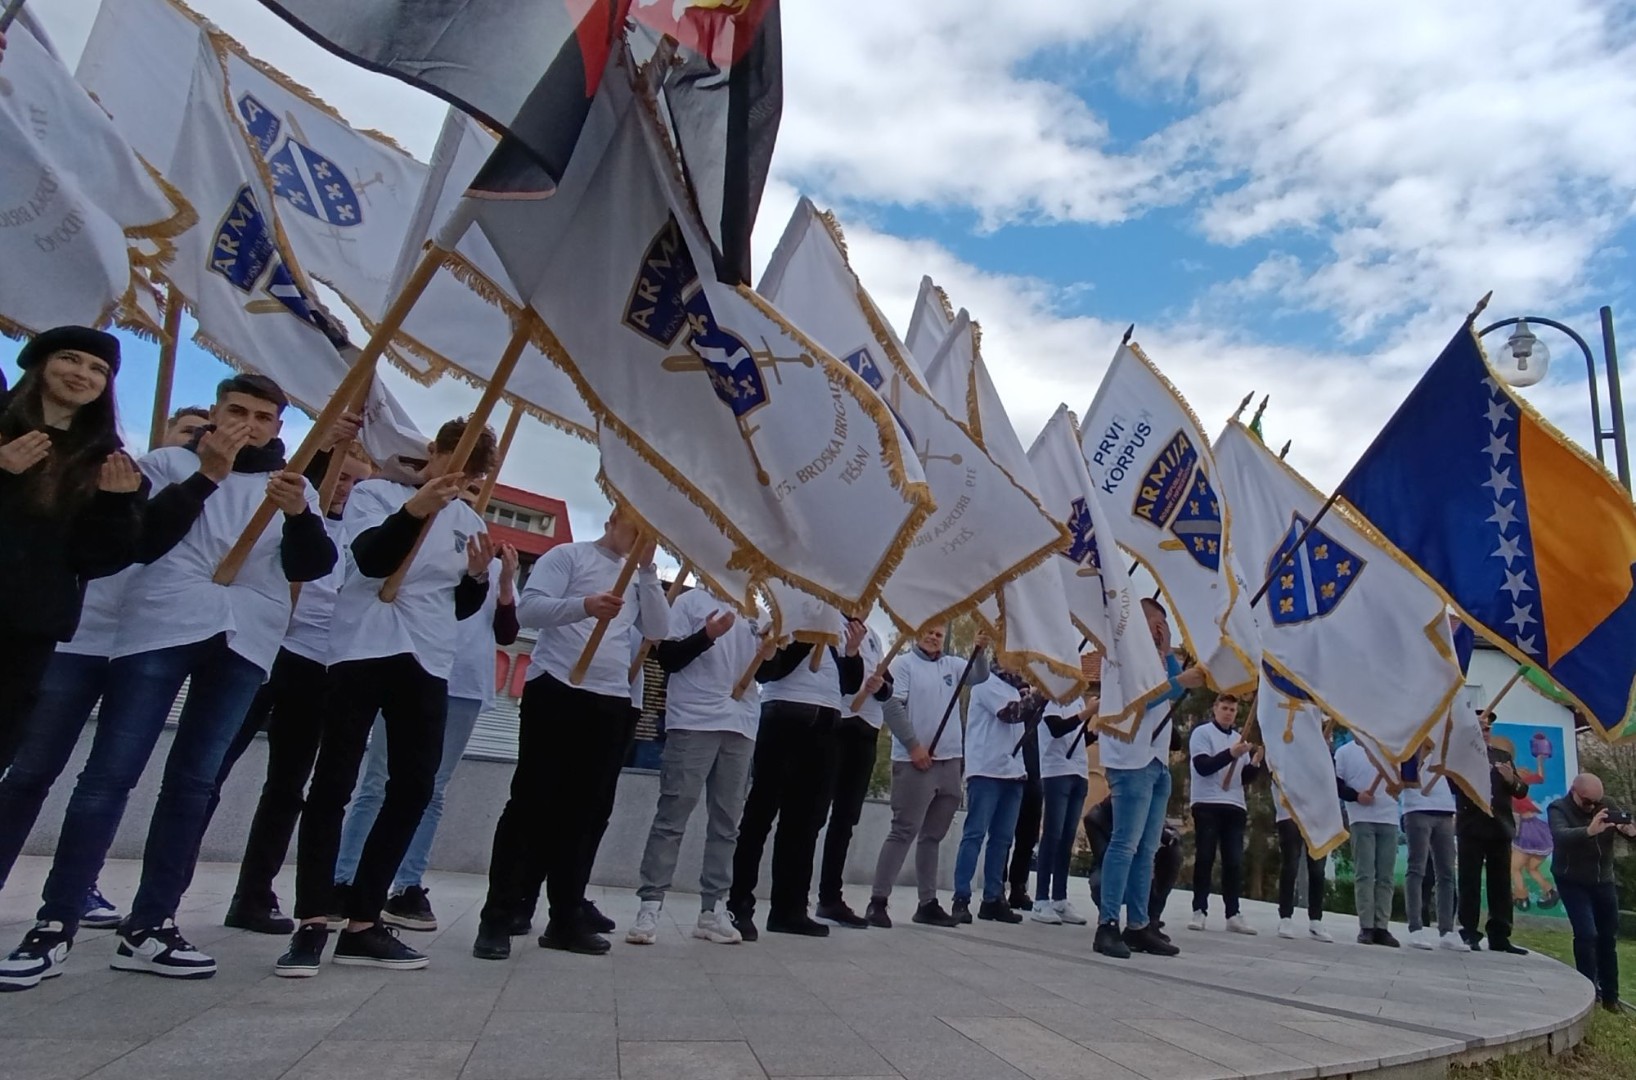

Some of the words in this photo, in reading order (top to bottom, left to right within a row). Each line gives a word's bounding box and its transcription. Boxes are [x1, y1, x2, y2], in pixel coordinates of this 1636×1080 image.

[795, 438, 845, 484] BRDSKA
[1093, 421, 1126, 466] PRVI
[1101, 421, 1152, 495] KORPUS
[1136, 434, 1190, 518] ARMIJA
